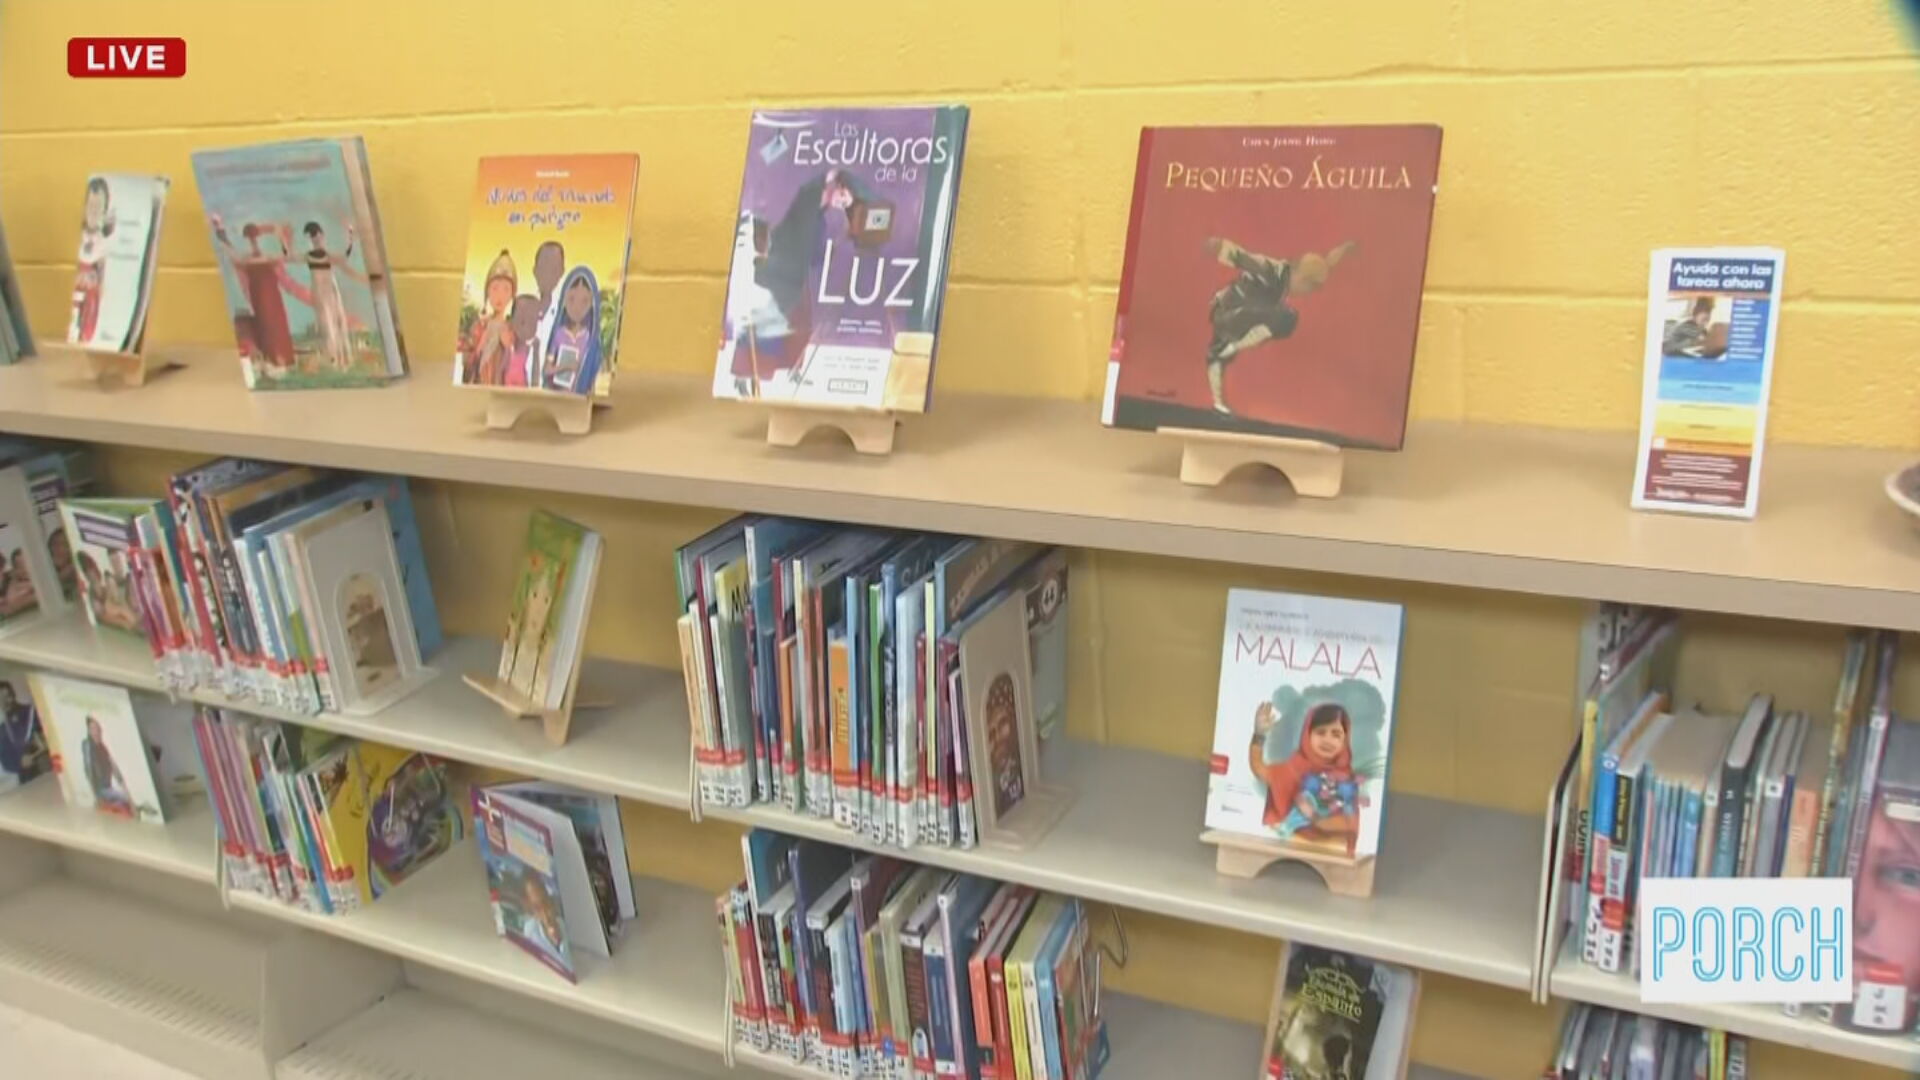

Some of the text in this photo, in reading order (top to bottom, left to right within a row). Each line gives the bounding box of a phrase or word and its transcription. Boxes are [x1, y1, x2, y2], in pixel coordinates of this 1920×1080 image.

[834, 120, 860, 137] Las
[793, 128, 949, 165] Escultoras
[874, 165, 917, 183] de la
[1165, 154, 1412, 193] PEQUEÑO ÁGUILA
[1673, 262, 1773, 276] Ayuda con las
[1676, 276, 1766, 290] tareas ahora
[1235, 631, 1383, 680] MALALA
